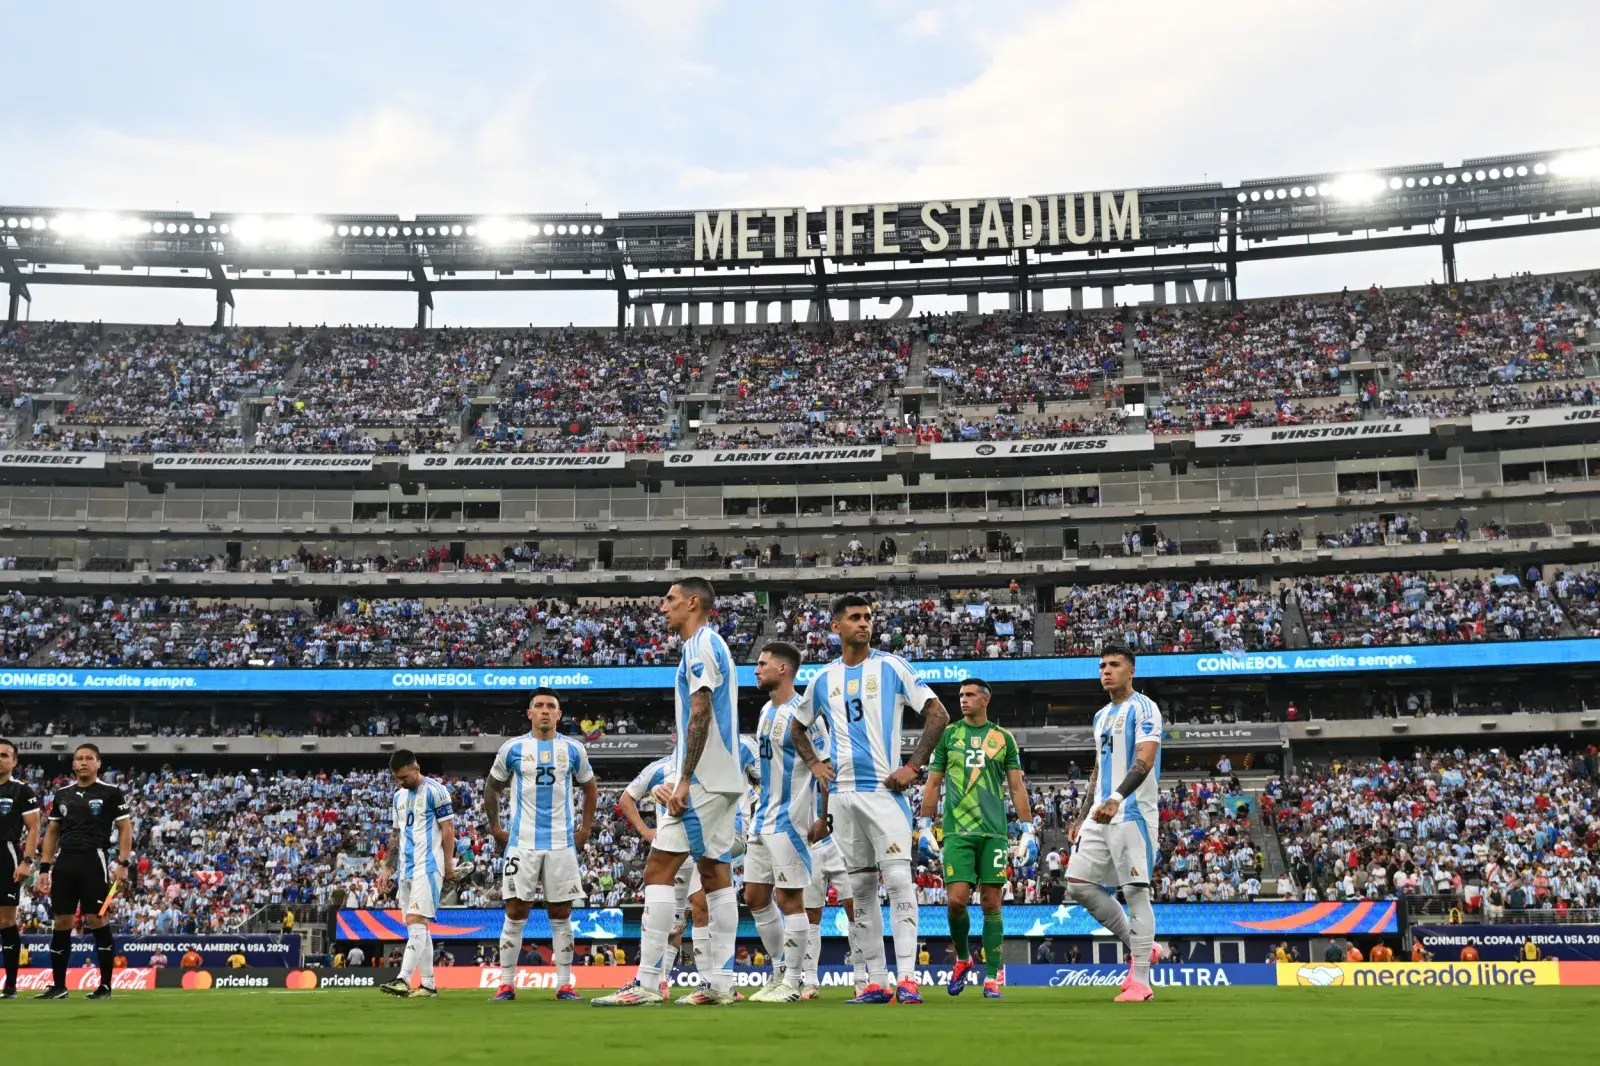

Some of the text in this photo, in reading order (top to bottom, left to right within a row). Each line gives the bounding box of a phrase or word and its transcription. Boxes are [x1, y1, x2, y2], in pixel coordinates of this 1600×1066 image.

[694, 190, 1141, 260] METLIFE STADIUM
[1506, 415, 1530, 425] 73
[1219, 424, 1403, 443] 75 WINSTON HILL
[1009, 440, 1108, 453] LEON HESS
[2, 454, 87, 465] CHREBET
[293, 458, 371, 466] FERGUSON
[423, 456, 611, 466] 99 MARK GASTINEAU
[669, 449, 875, 463] 60 LARRY GRANTHAM
[1197, 654, 1416, 671] CONMEBOL Acredite sempre.
[944, 665, 971, 681] big.
[84, 675, 140, 687] Acredite
[144, 675, 197, 689] sempre.
[392, 673, 593, 688] CONMEBOL Cree en grande.
[845, 698, 863, 723] 13
[1186, 729, 1252, 738] MetLife
[14, 741, 42, 750] etLife
[583, 741, 638, 749] MetLife
[760, 736, 773, 760] 20
[1100, 734, 1113, 754] 24
[965, 750, 986, 768] 23
[535, 766, 556, 786] 25
[504, 856, 520, 877] 25
[71, 943, 94, 952] 2024
[123, 942, 176, 952] CONMEBOL
[204, 942, 246, 952] AMERICA
[247, 943, 265, 952] USA
[267, 943, 289, 953] 2024
[1423, 936, 1482, 946] CONMEBOL
[1484, 936, 1514, 945] COPA
[1564, 935, 1585, 945] USA
[216, 974, 269, 988] priceless
[320, 974, 374, 988] priceless
[1049, 968, 1229, 986] Michelob ULTRA
[1353, 963, 1536, 985] mercado libre
